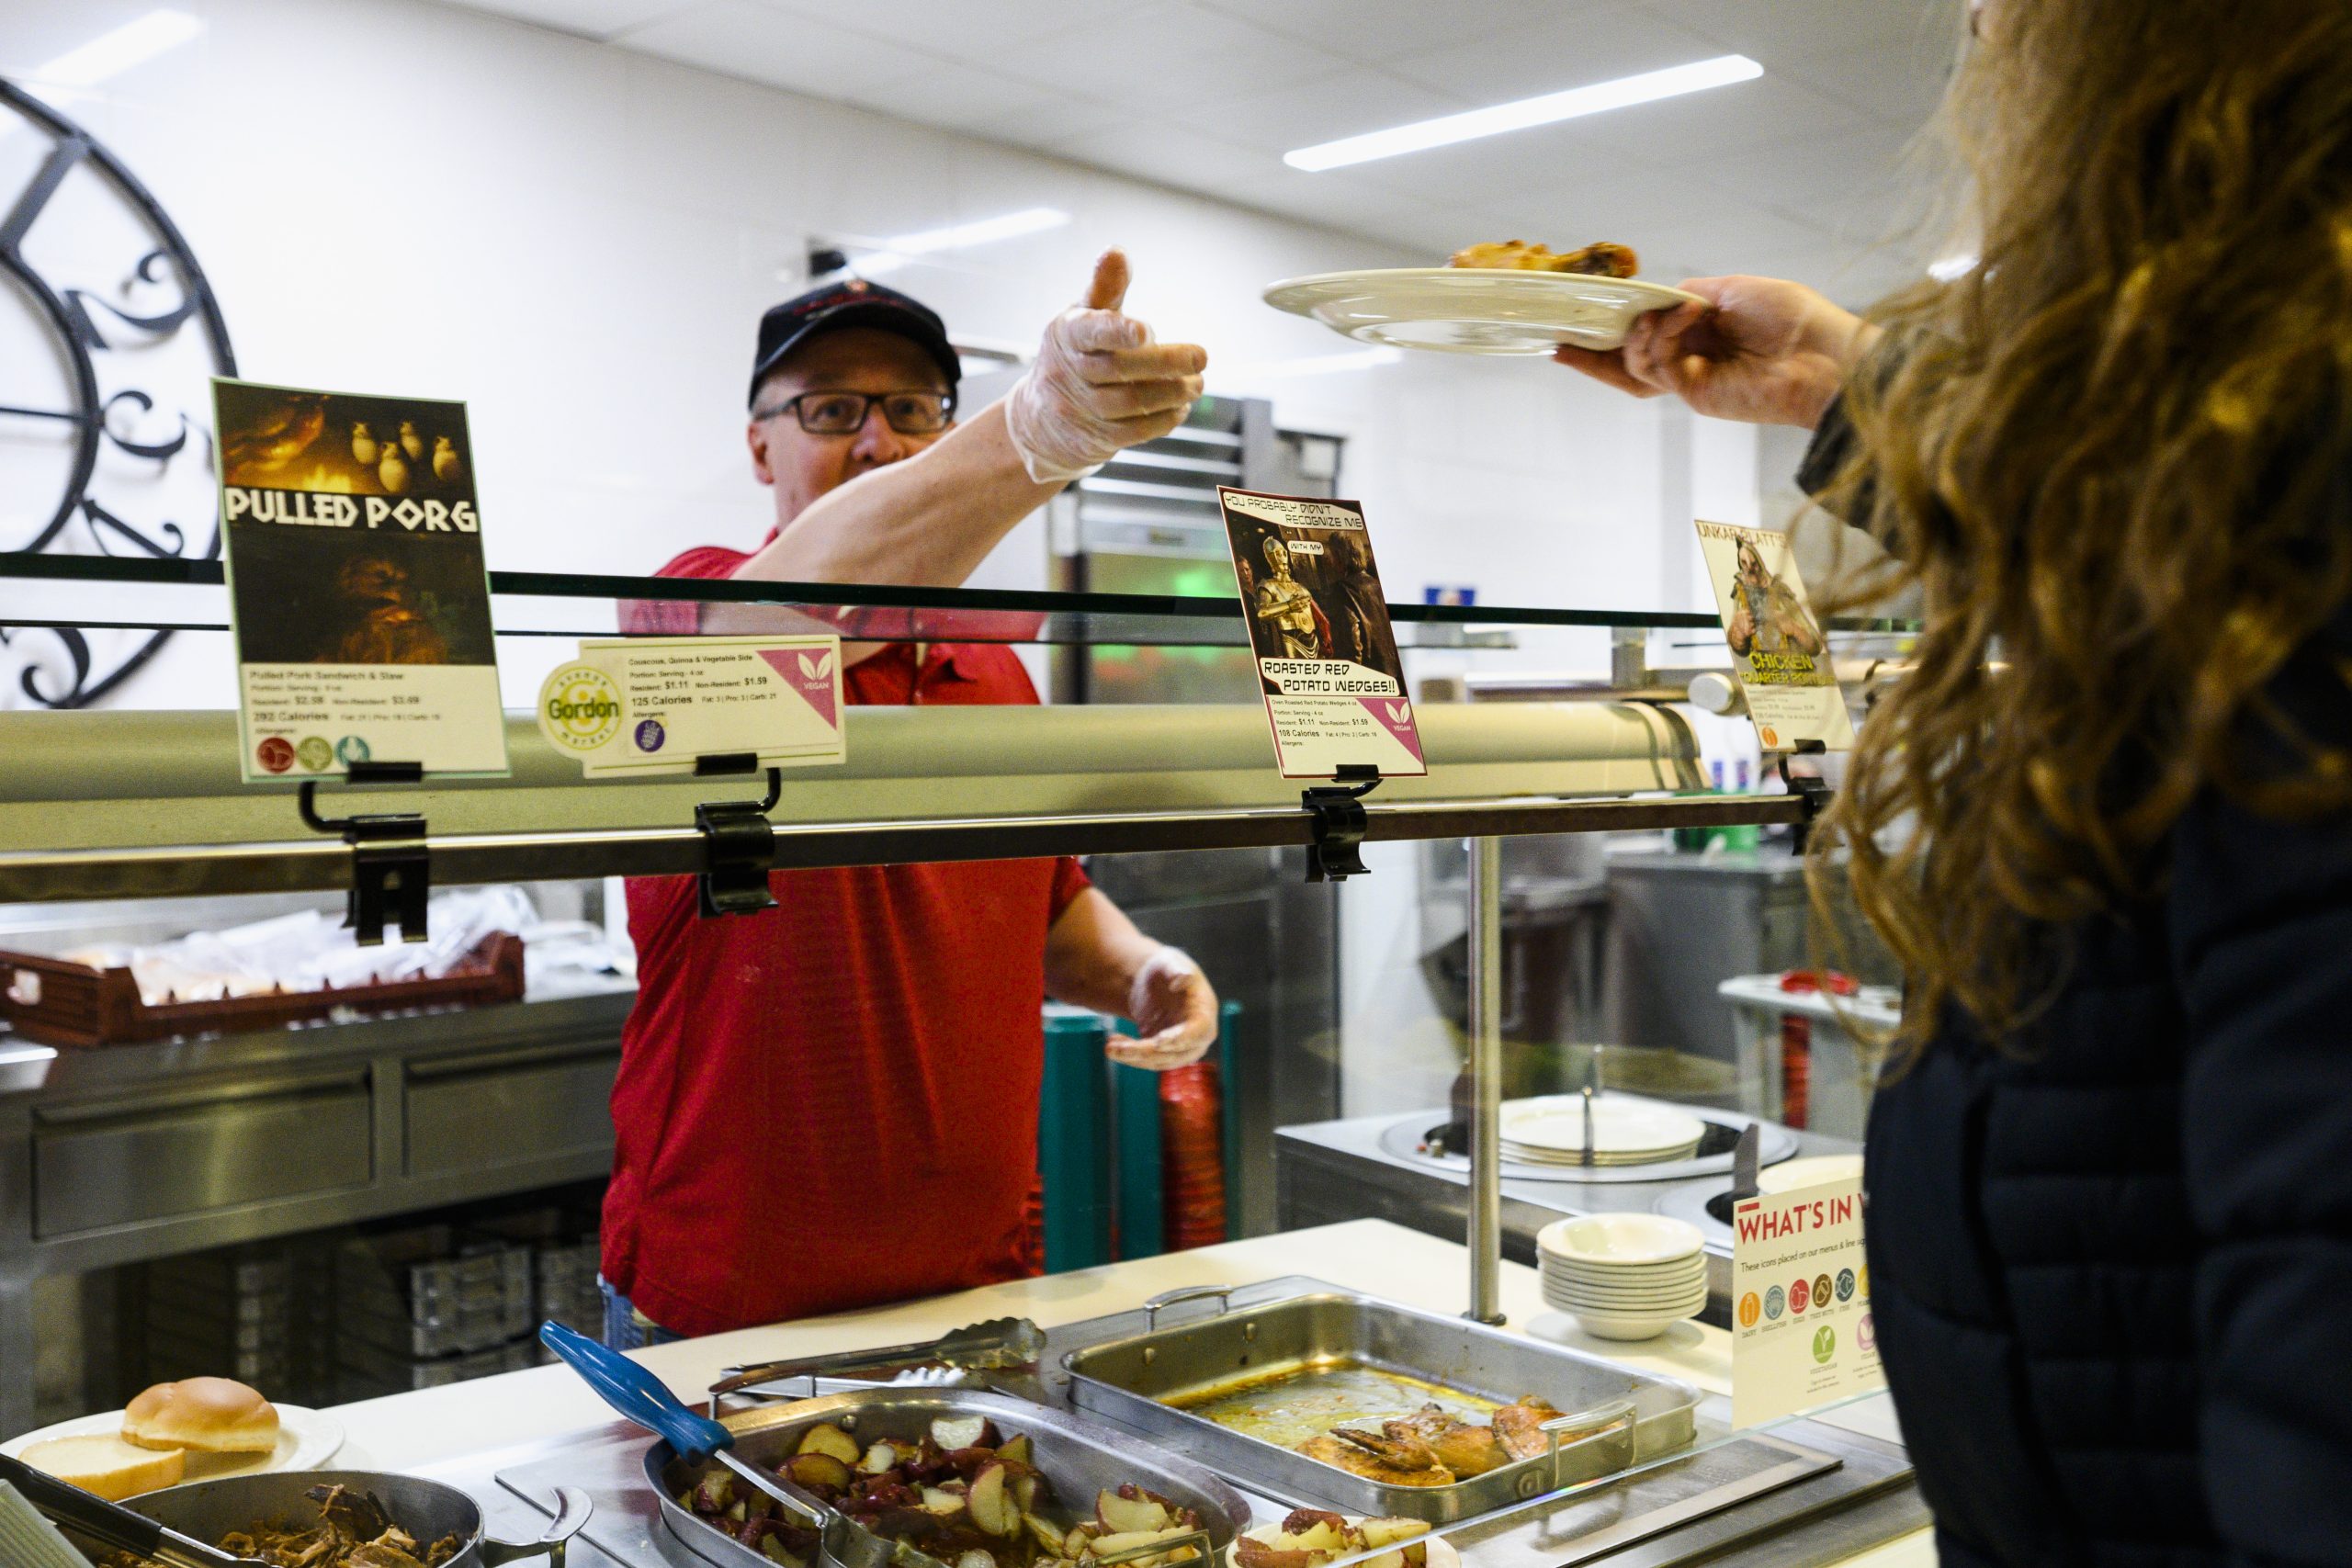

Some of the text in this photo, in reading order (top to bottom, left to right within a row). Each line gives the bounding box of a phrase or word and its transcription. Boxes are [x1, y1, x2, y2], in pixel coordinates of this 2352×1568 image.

[225, 488, 479, 533] PULLED PORG
[1225, 494, 1331, 514] YOU PROBABLY DIDN'T
[1285, 513, 1363, 527] RECOGNIZE ME
[1290, 543, 1308, 551] WITH
[703, 655, 735, 664] Vegetable
[1748, 651, 1815, 671] CHICKEN
[1264, 661, 1350, 676] ROASTED RED
[664, 681, 689, 690] $1.11
[743, 676, 768, 686] $1.59
[803, 682, 830, 690] VEGAN
[1283, 679, 1396, 694] POTATO WEDGES!!
[632, 697, 649, 706] 125
[651, 695, 693, 705] Calories
[548, 696, 619, 721] Gordon
[1292, 729, 1320, 738] Calories
[1737, 1201, 1825, 1246] WHAT'S
[1830, 1194, 1851, 1226] IN
[1741, 1262, 1760, 1272] These
[1760, 1258, 1777, 1269] icons
[1777, 1249, 1799, 1267] placed
[1799, 1251, 1807, 1259] on
[1808, 1249, 1818, 1258] our
[1819, 1246, 1838, 1256] menus
[1838, 1241, 1845, 1250] &
[1845, 1238, 1856, 1249] line
